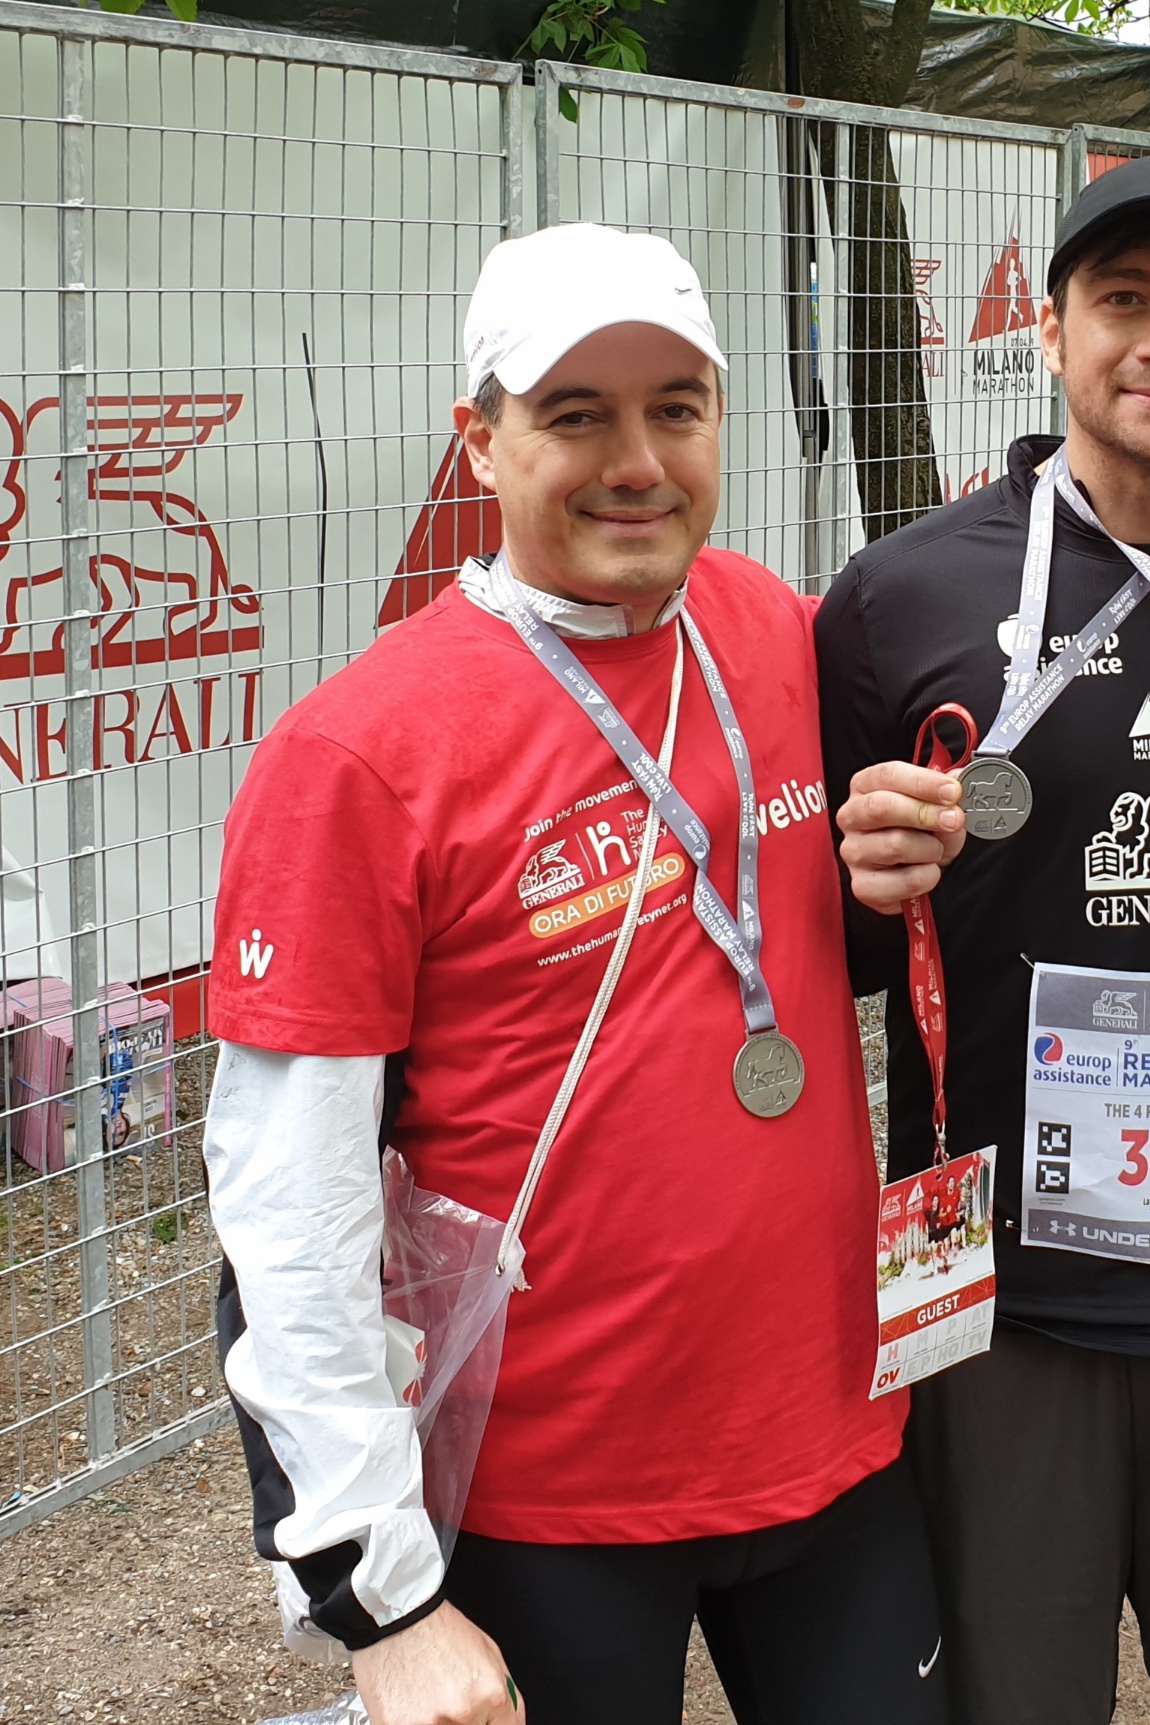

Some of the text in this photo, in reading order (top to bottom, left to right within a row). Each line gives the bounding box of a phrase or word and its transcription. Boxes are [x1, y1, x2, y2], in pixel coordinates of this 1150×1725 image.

[973, 350, 1035, 376] MILANO
[972, 378, 1035, 395] MARATHON
[515, 602, 539, 631] RELAY
[563, 669, 586, 693] MILANO
[1008, 700, 1030, 724] EUROP
[1029, 663, 1063, 703] ASSISTANCE
[1015, 709, 1034, 732] RELAY
[1032, 674, 1065, 711] MARATHON
[631, 760, 663, 802] RUN FAST
[639, 753, 672, 794] LIVE COOL
[524, 779, 639, 842] Join the movemen
[620, 809, 644, 823] The
[684, 824, 699, 844] europ
[522, 874, 585, 910] GENERALI
[534, 904, 582, 933] ORA
[585, 893, 605, 914] DI
[697, 883, 755, 972] RELAY MARATHON
[725, 942, 750, 975] EUROP
[1092, 1017, 1138, 1030] GENERALI
[1066, 1053, 1112, 1070] europ
[1033, 1067, 1112, 1087] assistance
[1104, 1102, 1130, 1118] THE
[1134, 1103, 1143, 1118] 4
[917, 1294, 960, 1325] GUEST
[877, 1367, 900, 1389] OV
[969, 1329, 988, 1349] TV
[887, 1343, 899, 1362] H
